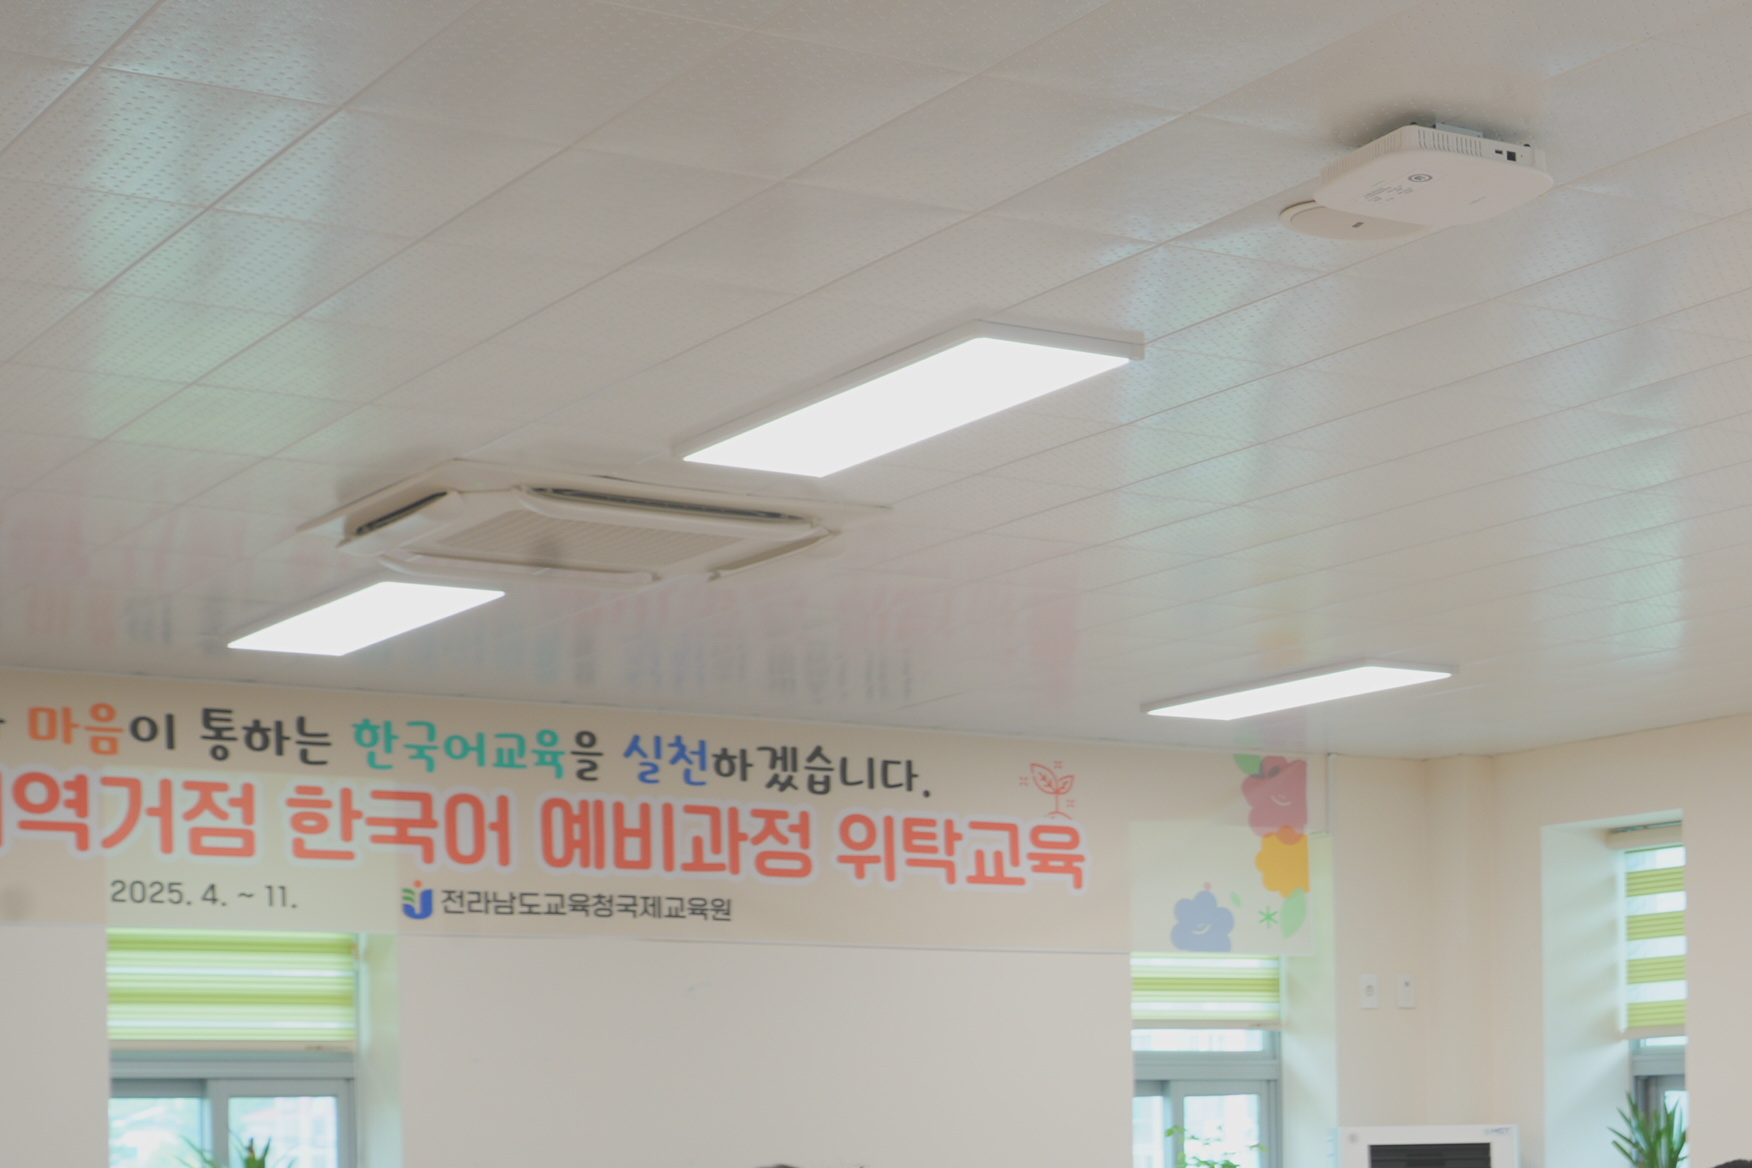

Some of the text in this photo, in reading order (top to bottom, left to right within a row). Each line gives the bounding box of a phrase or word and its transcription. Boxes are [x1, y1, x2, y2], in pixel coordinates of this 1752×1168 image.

[28, 703, 931, 798] 마음이 통하는 한국어교육을 실천하겠습니다.
[0, 772, 1085, 890] 역거점 한국어 예비과정 위탁교육
[110, 879, 193, 906] 2025.
[201, 883, 228, 907] 4.
[264, 884, 298, 909] 11.
